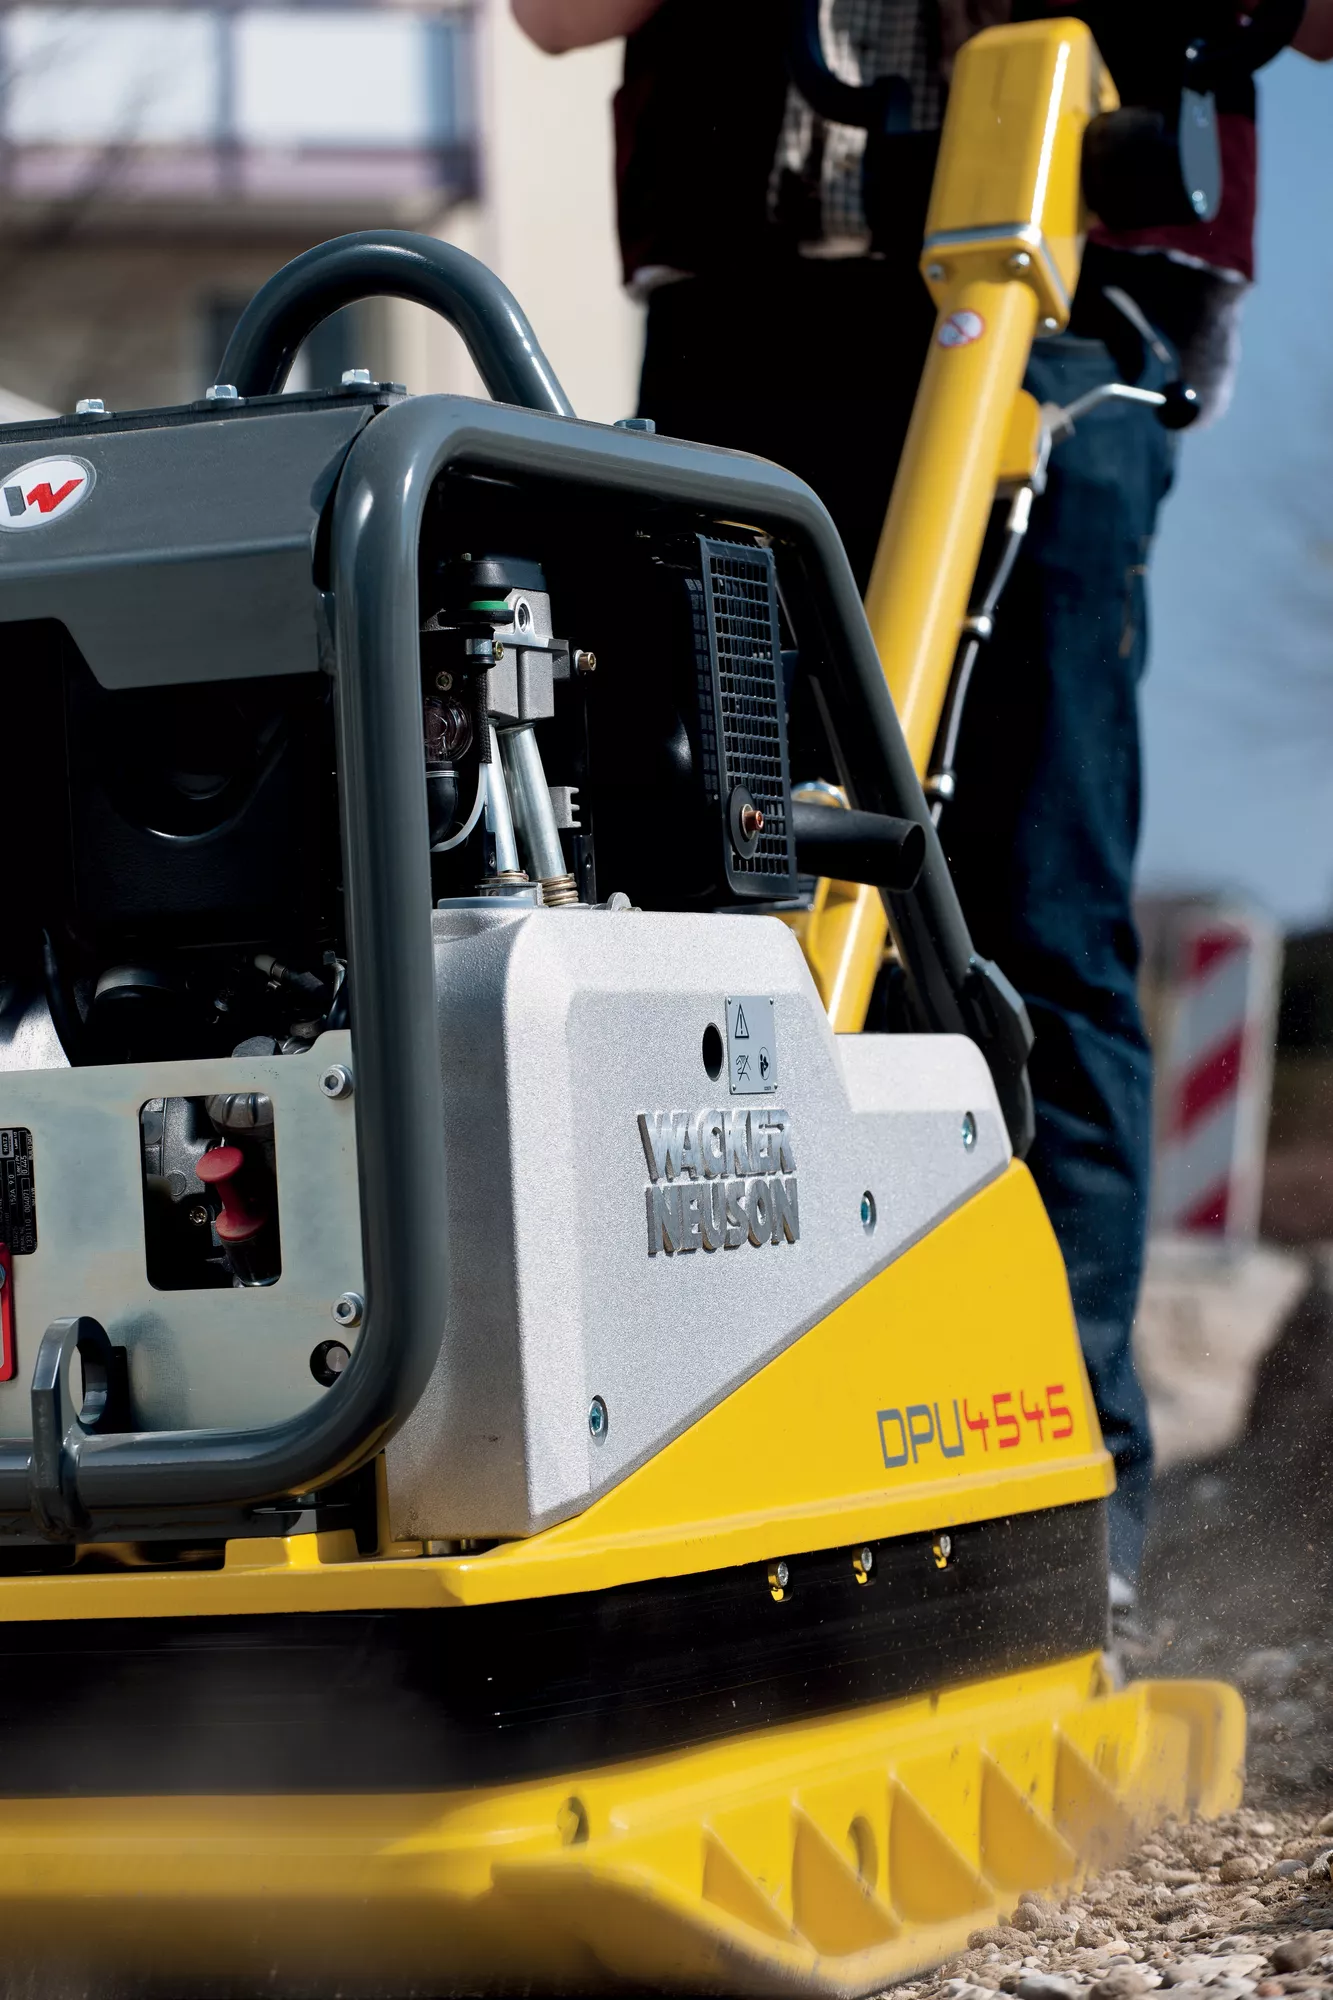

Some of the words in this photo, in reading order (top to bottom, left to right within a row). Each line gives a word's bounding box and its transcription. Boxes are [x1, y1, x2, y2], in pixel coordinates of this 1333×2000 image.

[637, 1110, 797, 1184] WACKER
[645, 1177, 800, 1257] NEUSON
[876, 1385, 1074, 1469] DPU4545
